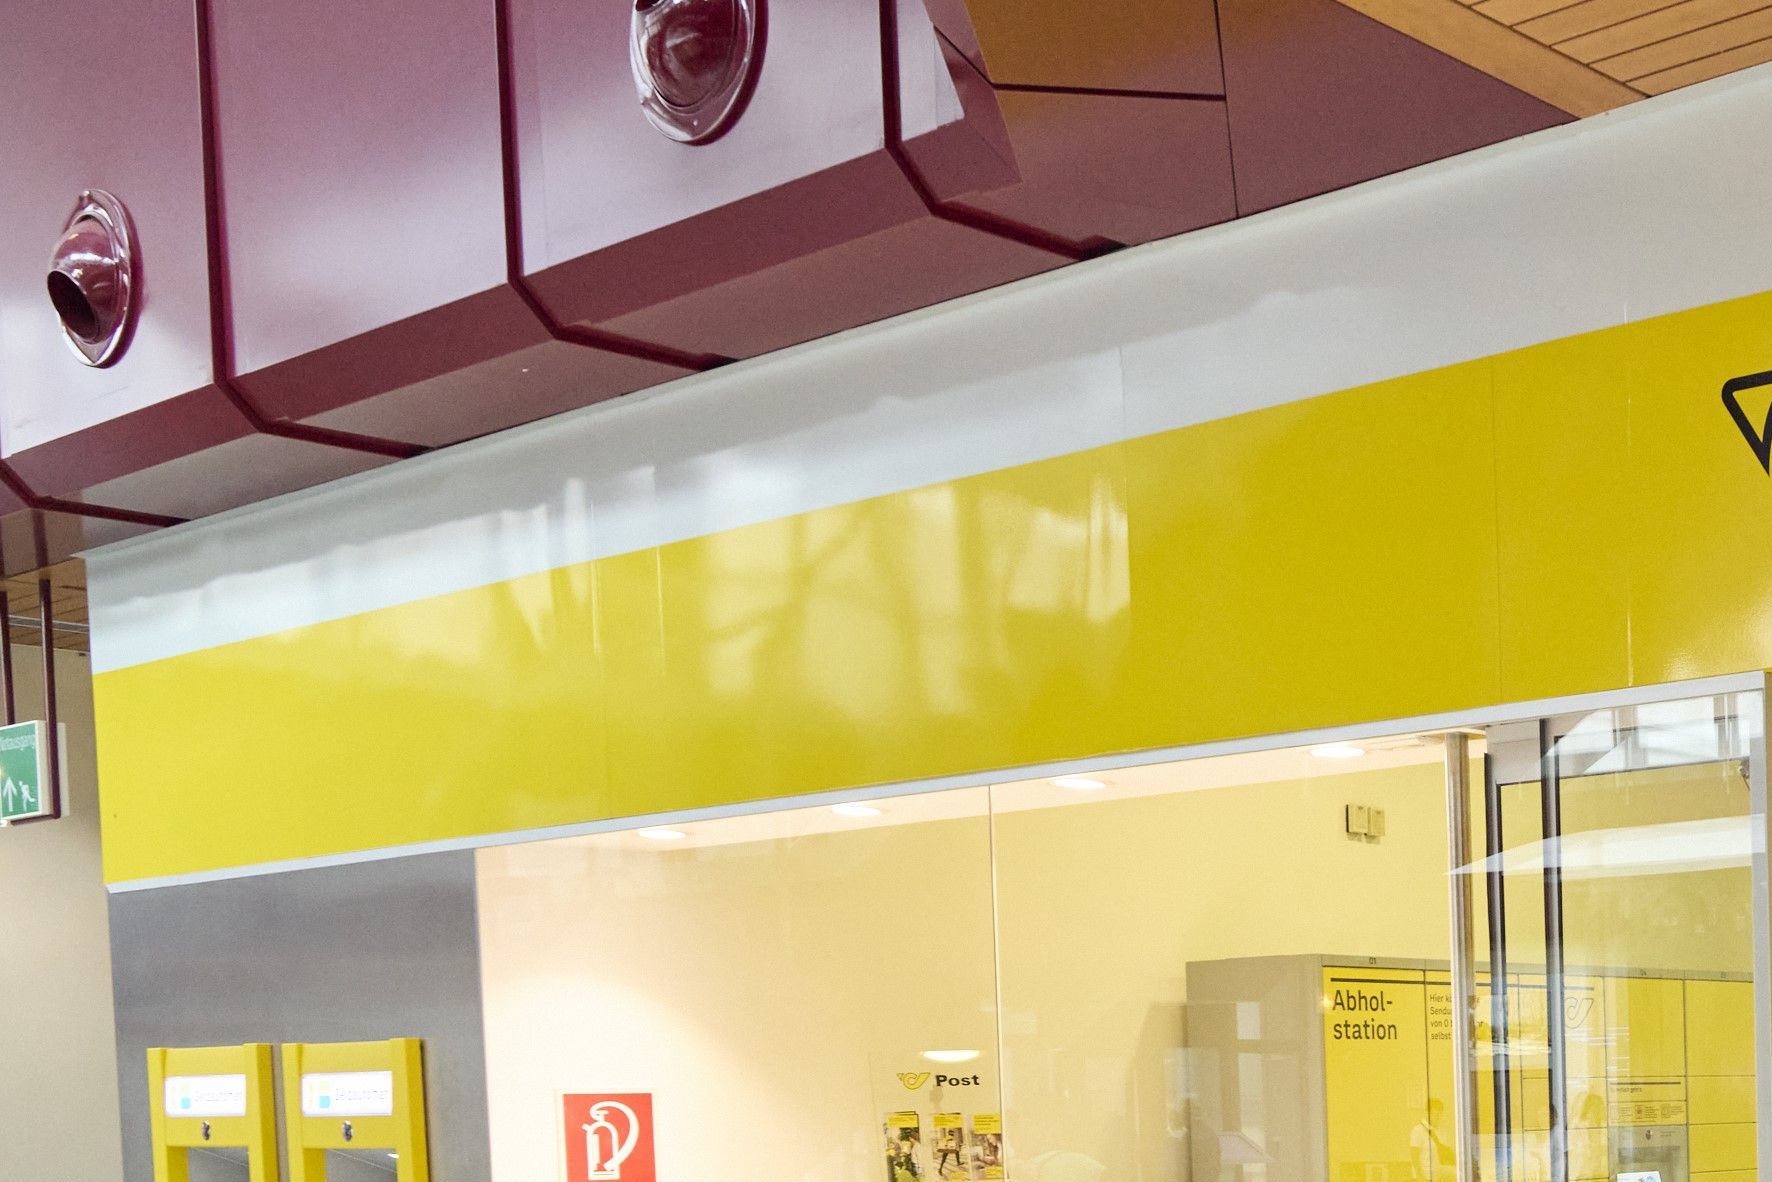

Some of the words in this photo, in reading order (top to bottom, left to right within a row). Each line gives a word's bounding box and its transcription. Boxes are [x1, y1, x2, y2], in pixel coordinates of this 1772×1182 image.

[1332, 990, 1393, 1012] Abhol-
[1430, 994, 1443, 1002] Hier
[1333, 1018, 1397, 1040] station
[1431, 1020, 1442, 1028] von
[935, 1074, 980, 1087] Post
